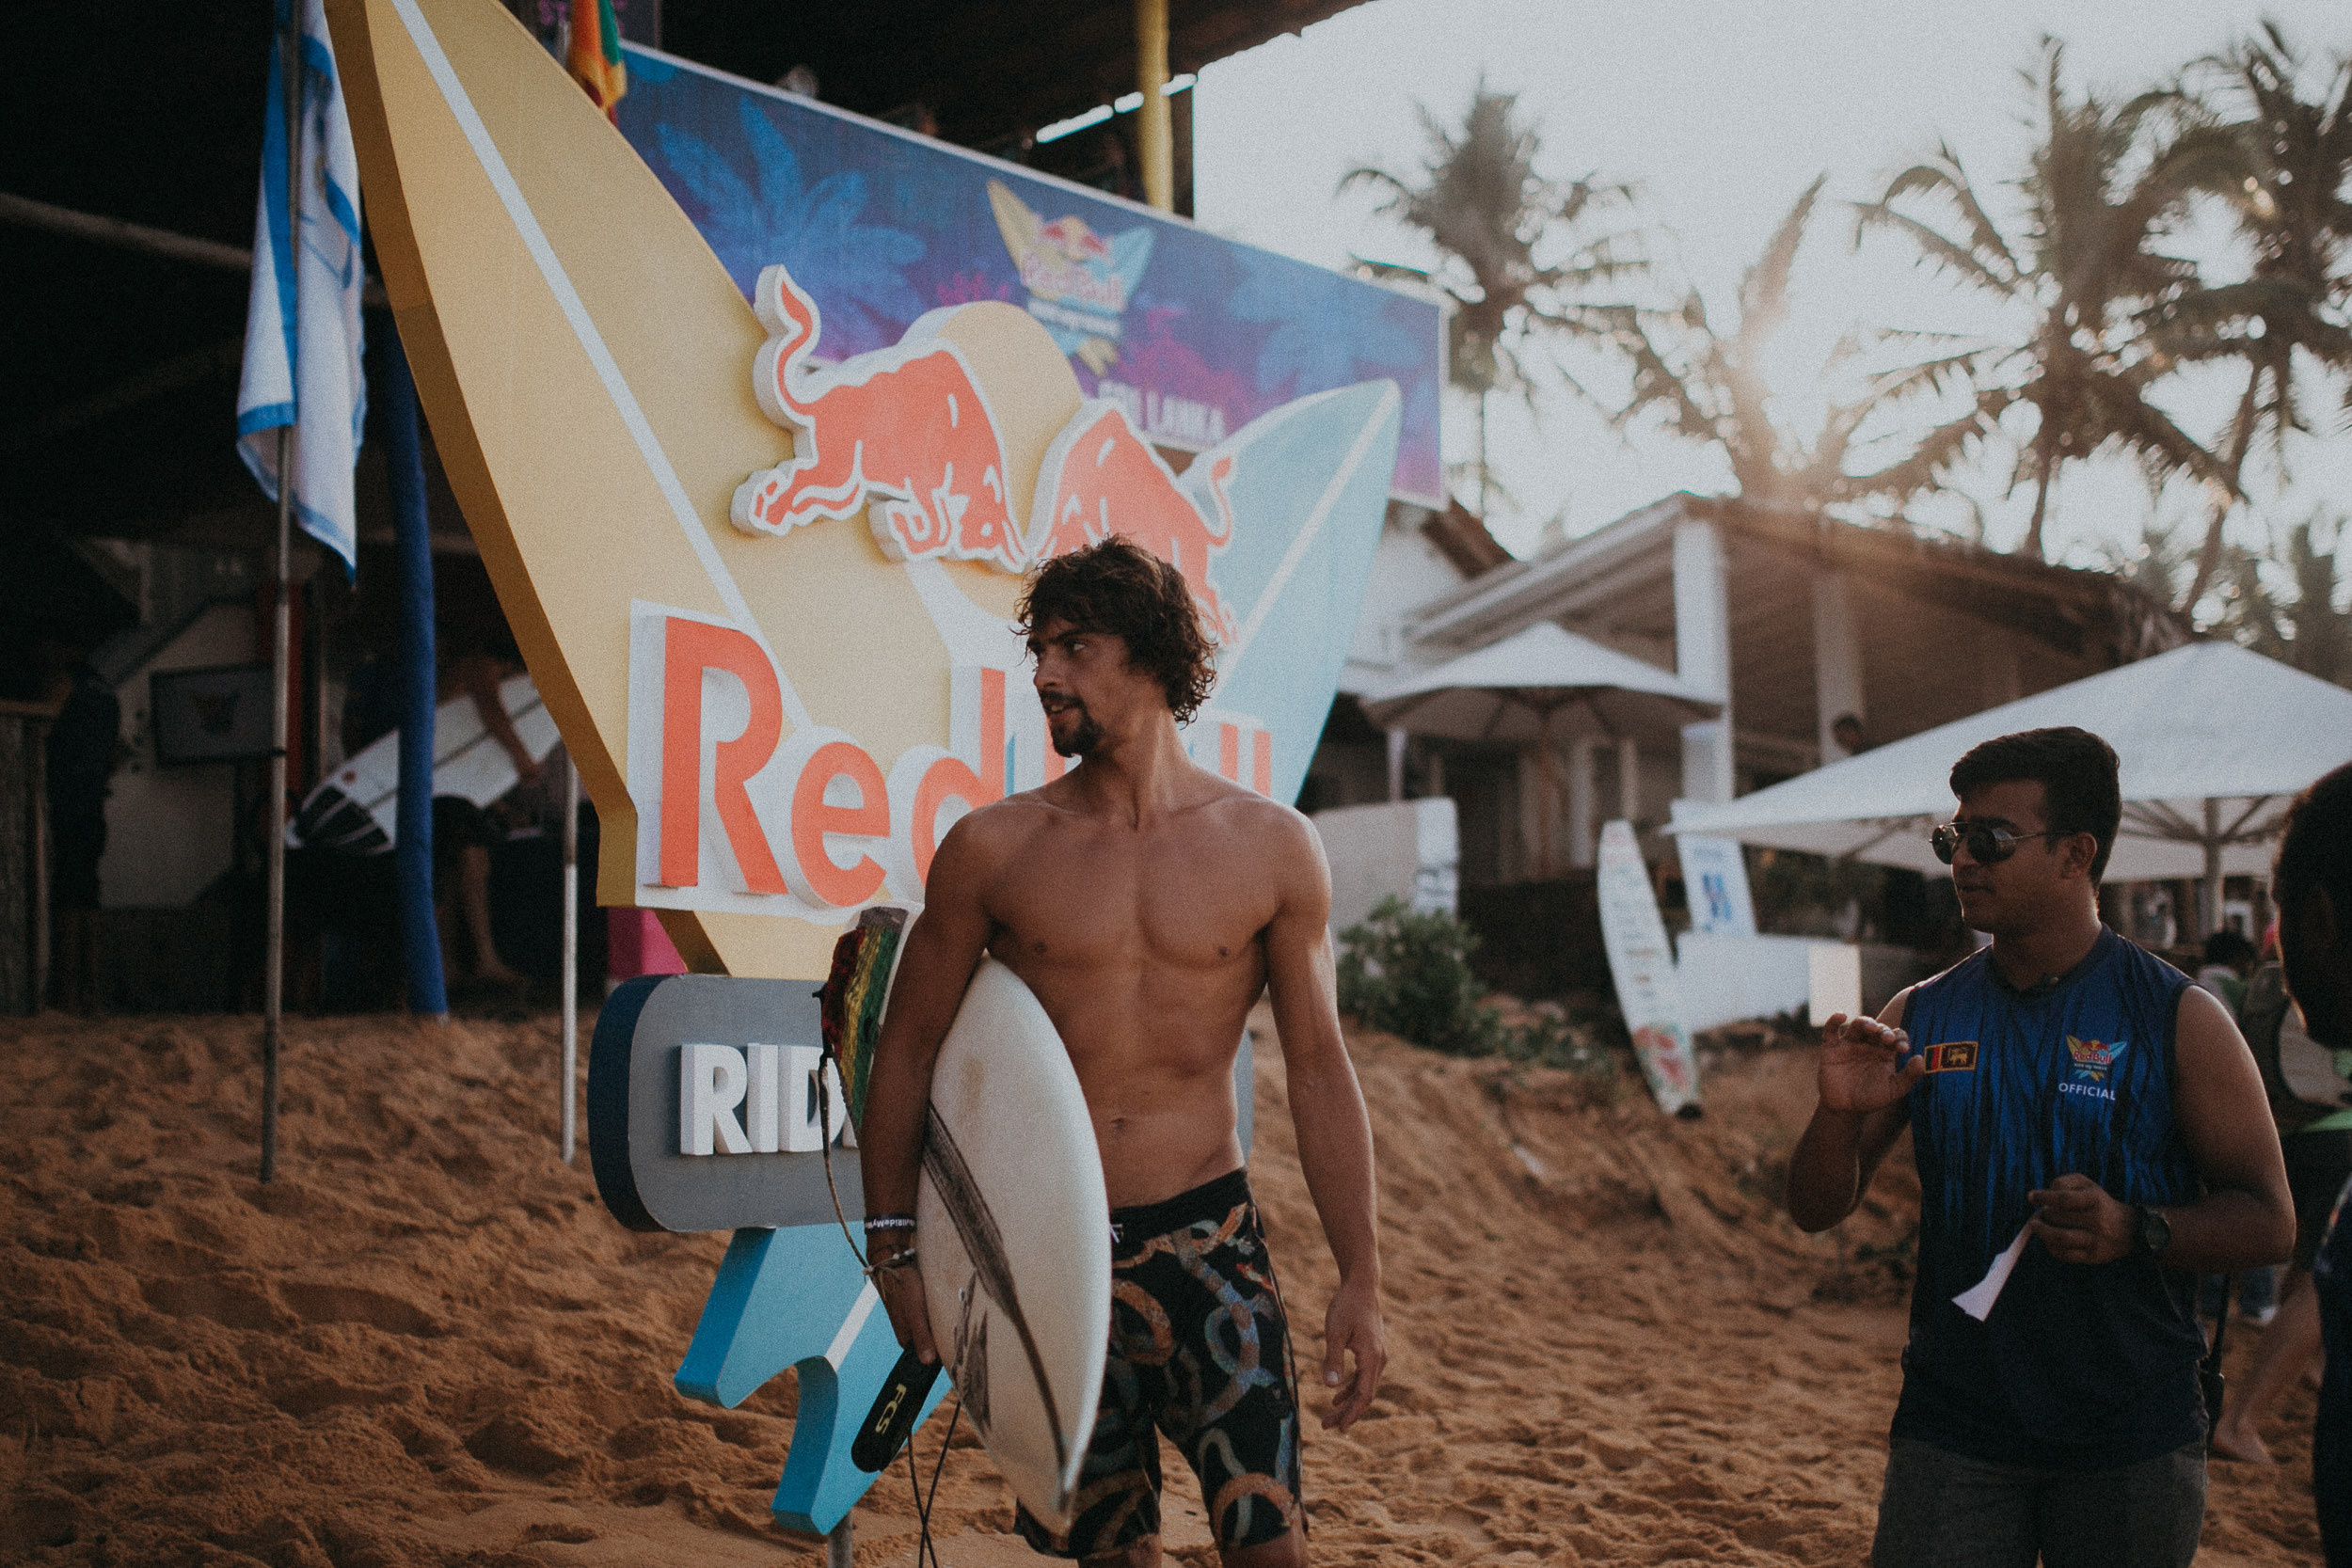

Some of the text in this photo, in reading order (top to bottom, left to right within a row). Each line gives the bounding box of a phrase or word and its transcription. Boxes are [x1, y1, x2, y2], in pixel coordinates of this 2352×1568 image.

[2074, 1050, 2112, 1065] Red Bull
[680, 1042, 860, 1156] RID
[2058, 1083, 2116, 1101] OFFICIAL
[875, 1383, 907, 1435] FCS
